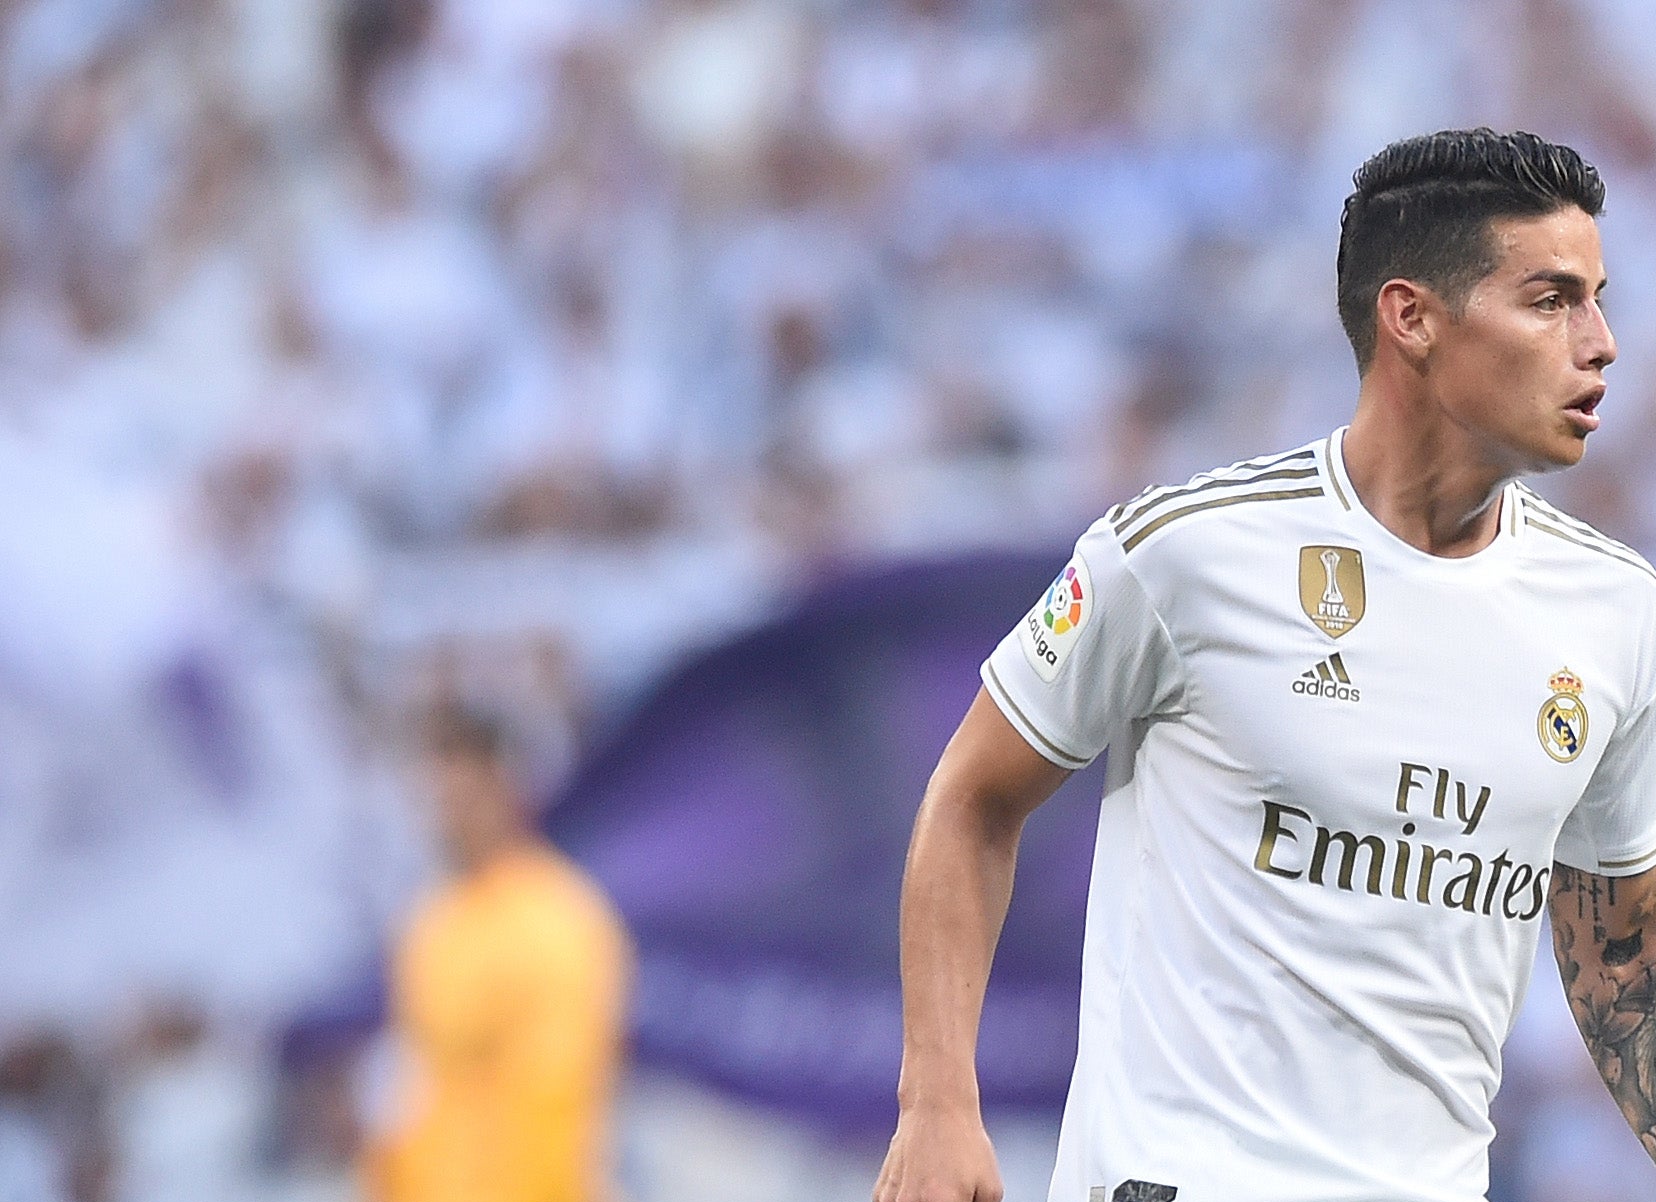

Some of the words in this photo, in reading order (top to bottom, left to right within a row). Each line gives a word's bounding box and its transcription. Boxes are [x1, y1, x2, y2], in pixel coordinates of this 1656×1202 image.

[1318, 602, 1350, 618] FIFA
[1292, 679, 1361, 703] adidas
[1396, 761, 1492, 836] Fly
[1253, 799, 1550, 922] Emirates
